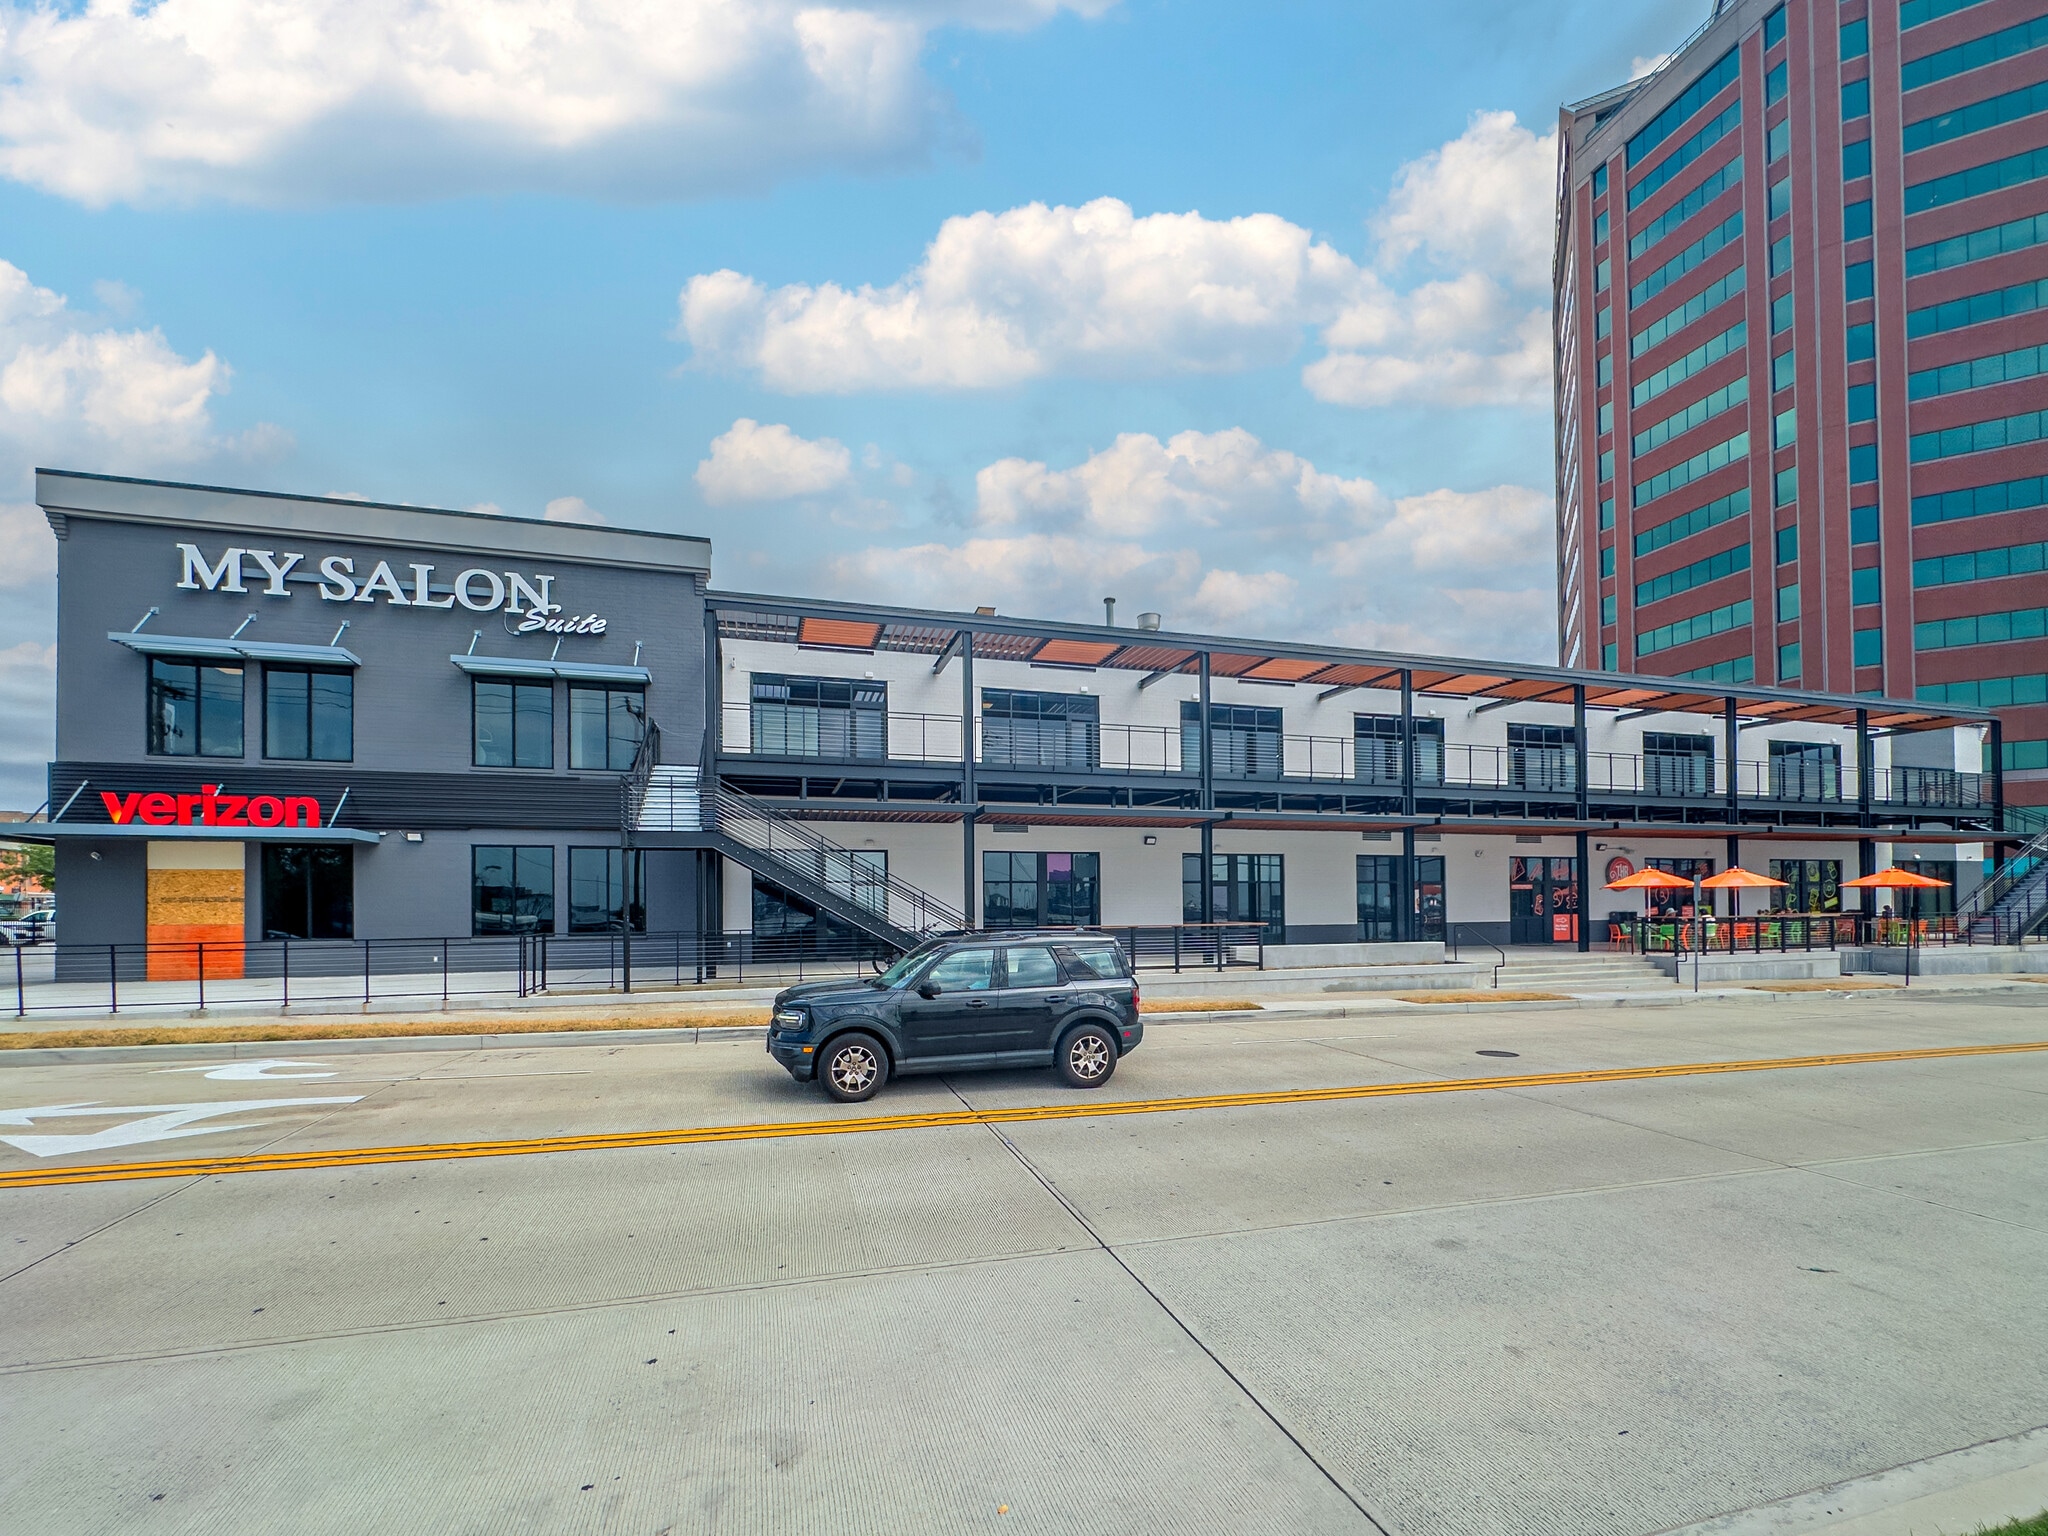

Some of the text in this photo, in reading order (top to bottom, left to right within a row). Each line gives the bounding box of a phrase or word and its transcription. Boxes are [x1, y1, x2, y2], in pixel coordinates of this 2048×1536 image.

[176, 543, 555, 614] MY SALON
[518, 603, 608, 635] Suite
[100, 784, 321, 828] verizon
